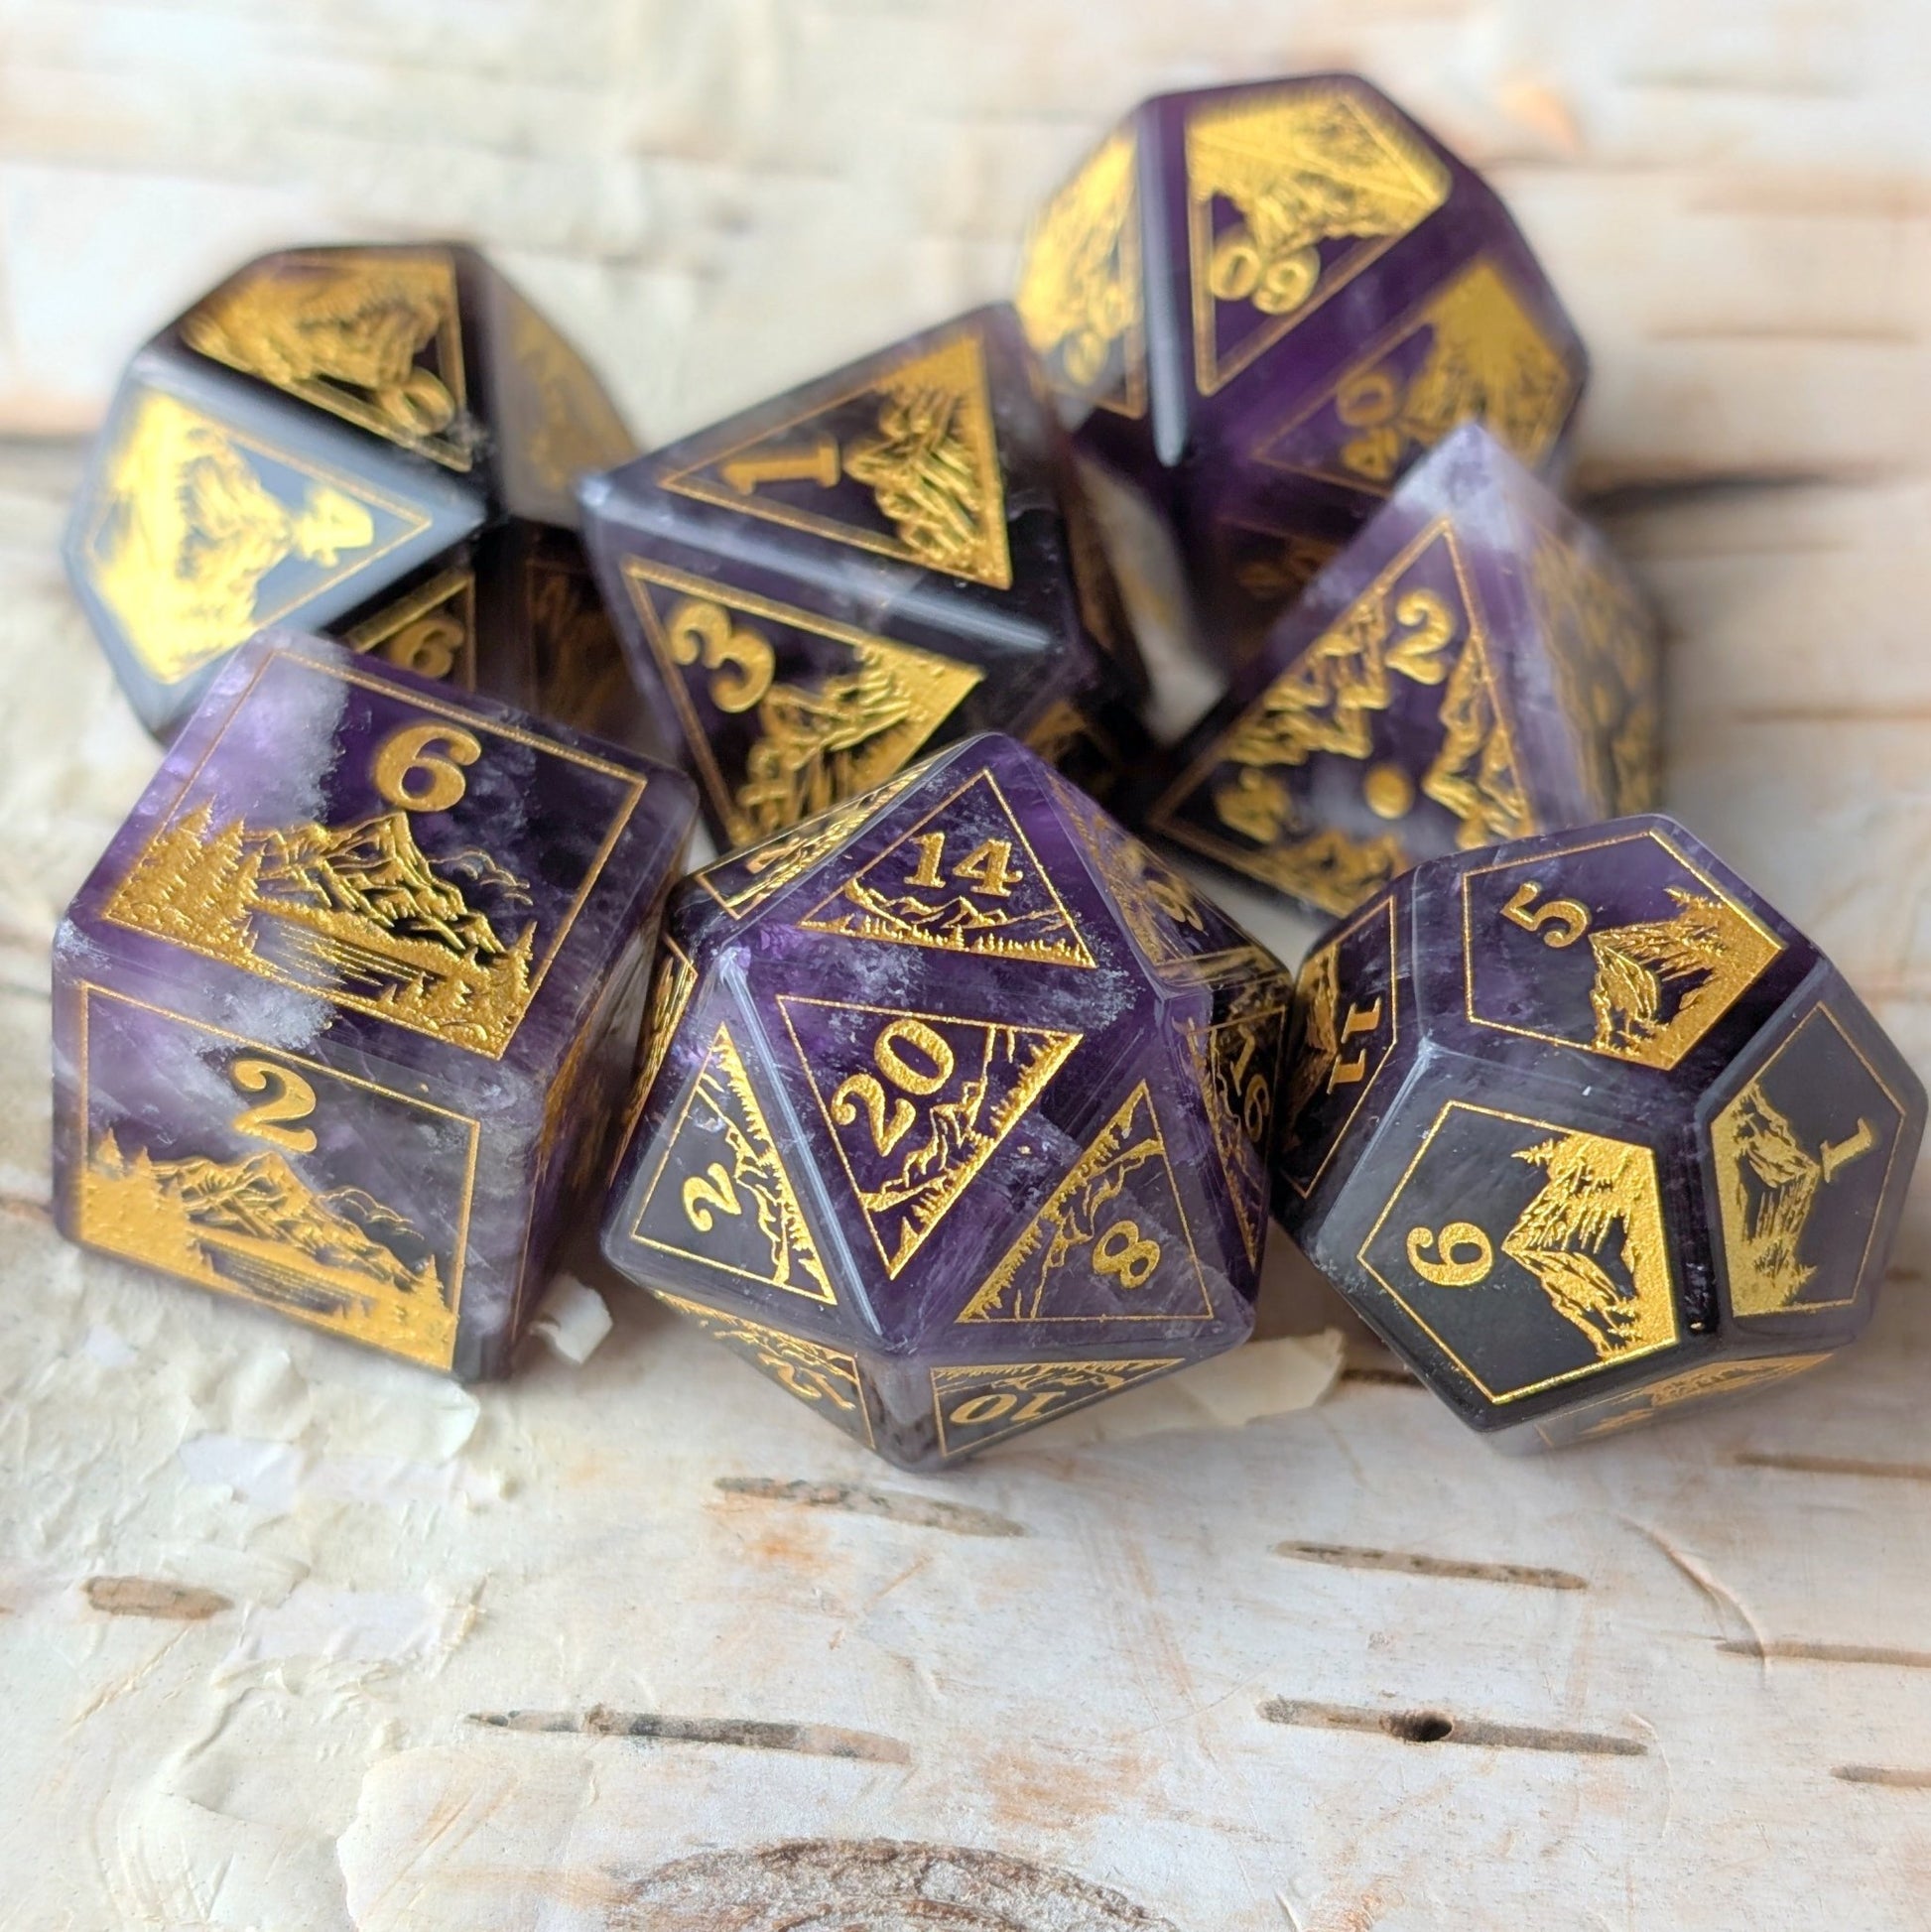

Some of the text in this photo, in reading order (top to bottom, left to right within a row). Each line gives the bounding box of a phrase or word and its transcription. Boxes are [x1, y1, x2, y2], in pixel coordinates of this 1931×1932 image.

[721, 437, 840, 494] 1
[667, 600, 775, 712] 3
[1386, 589, 1453, 686] 2
[372, 721, 481, 812] 6
[904, 832, 1023, 897] 14
[1499, 881, 1591, 949] 5
[1229, 1024, 1270, 1142] 16
[1327, 996, 1381, 1095] 11
[229, 1059, 317, 1154] 2
[832, 1020, 955, 1156] 20
[1819, 1117, 1873, 1182] 1
[683, 1163, 741, 1231] 2
[1091, 1221, 1160, 1289] 8
[950, 1391, 1067, 1425] 10
